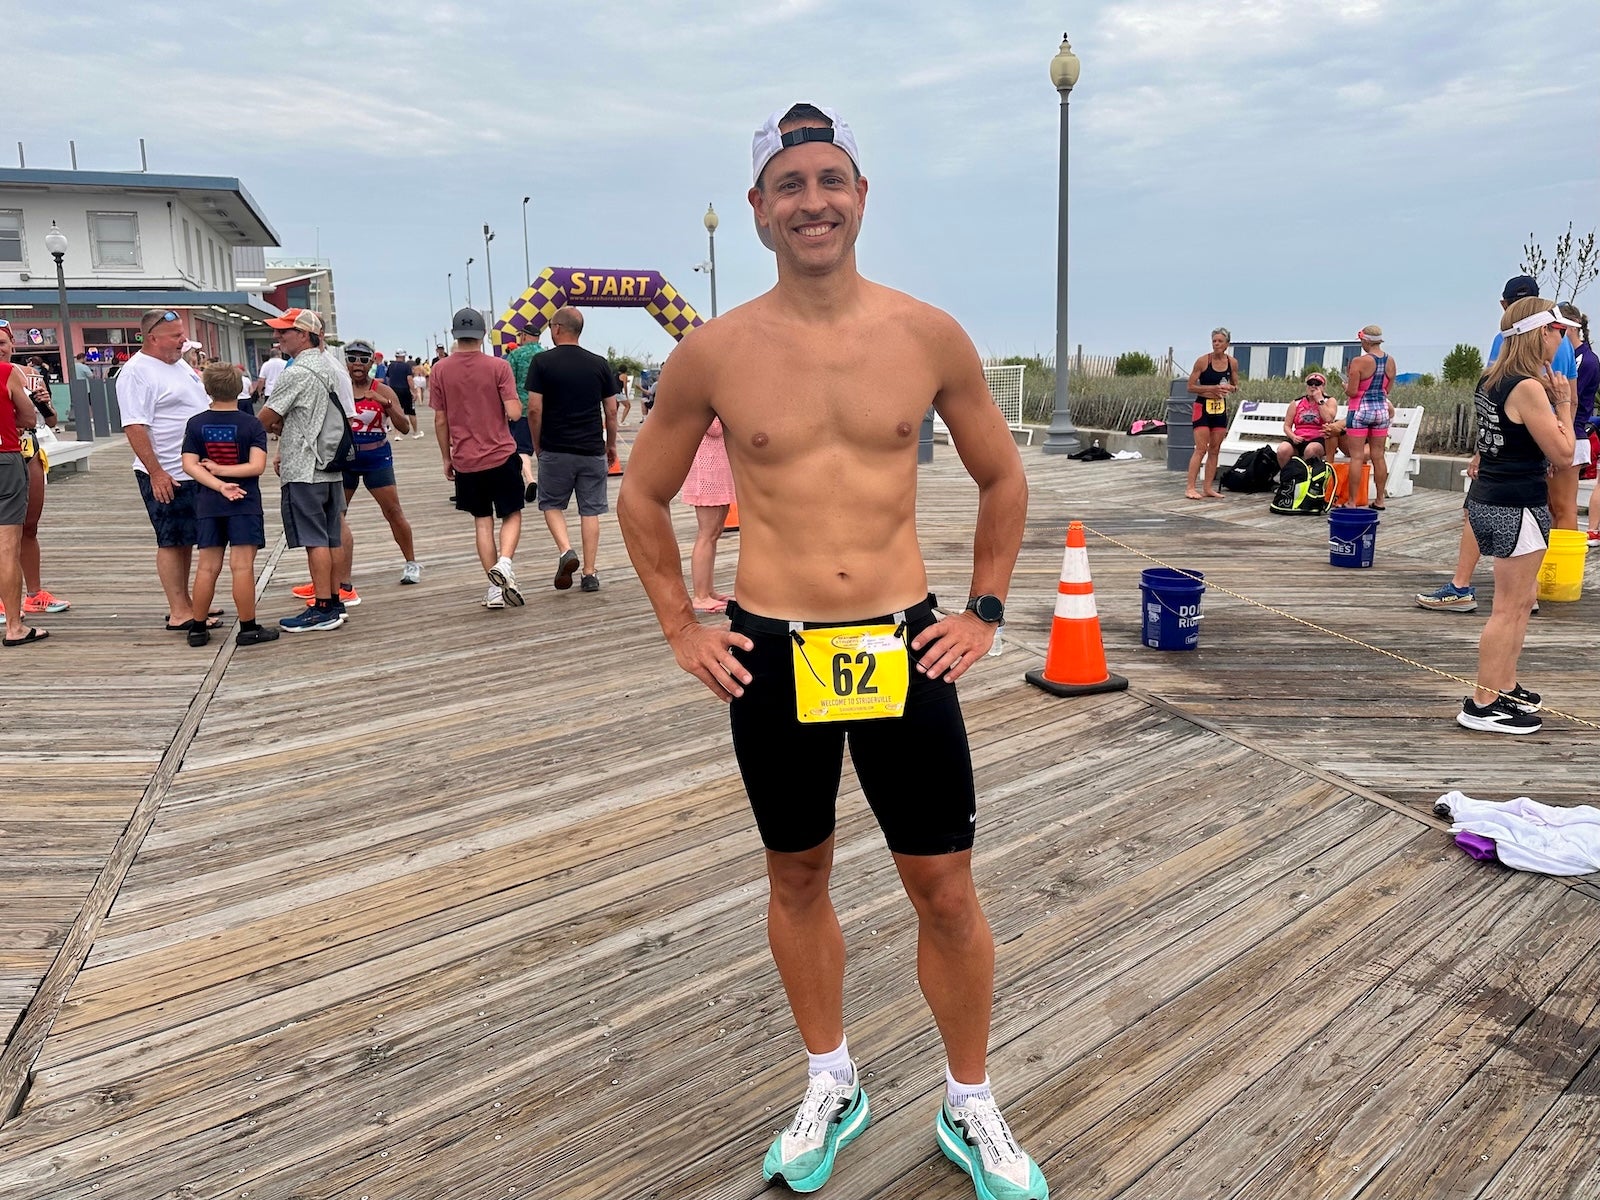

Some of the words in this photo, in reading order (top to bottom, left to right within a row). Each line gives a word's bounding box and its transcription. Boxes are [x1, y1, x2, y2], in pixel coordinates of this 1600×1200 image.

[570, 272, 651, 296] START
[832, 651, 878, 696] 62
[821, 698, 846, 706] WELCOME
[856, 696, 892, 704] STRIDERVILLE
